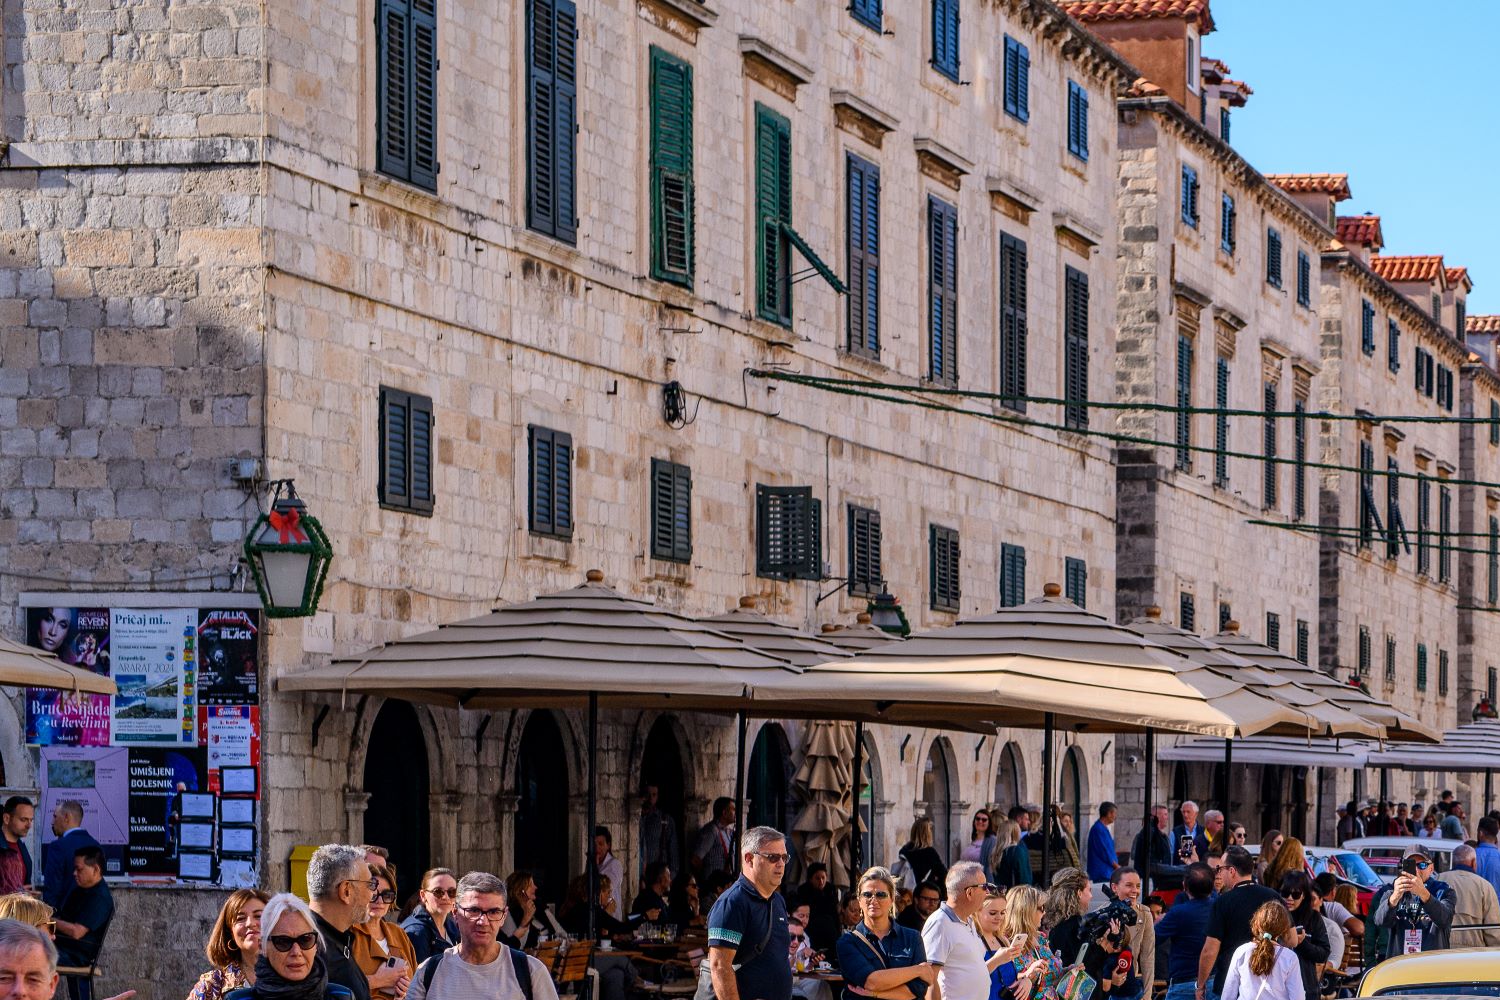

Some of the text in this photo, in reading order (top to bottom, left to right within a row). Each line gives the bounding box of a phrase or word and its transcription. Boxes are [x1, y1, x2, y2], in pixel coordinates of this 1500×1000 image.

[115, 614, 146, 626] Pričaj
[220, 630, 252, 640] BLACK
[118, 663, 174, 673] ARARAT 2024
[130, 766, 174, 777] UMIŠLJENI
[130, 779, 173, 788] BOLESNIK
